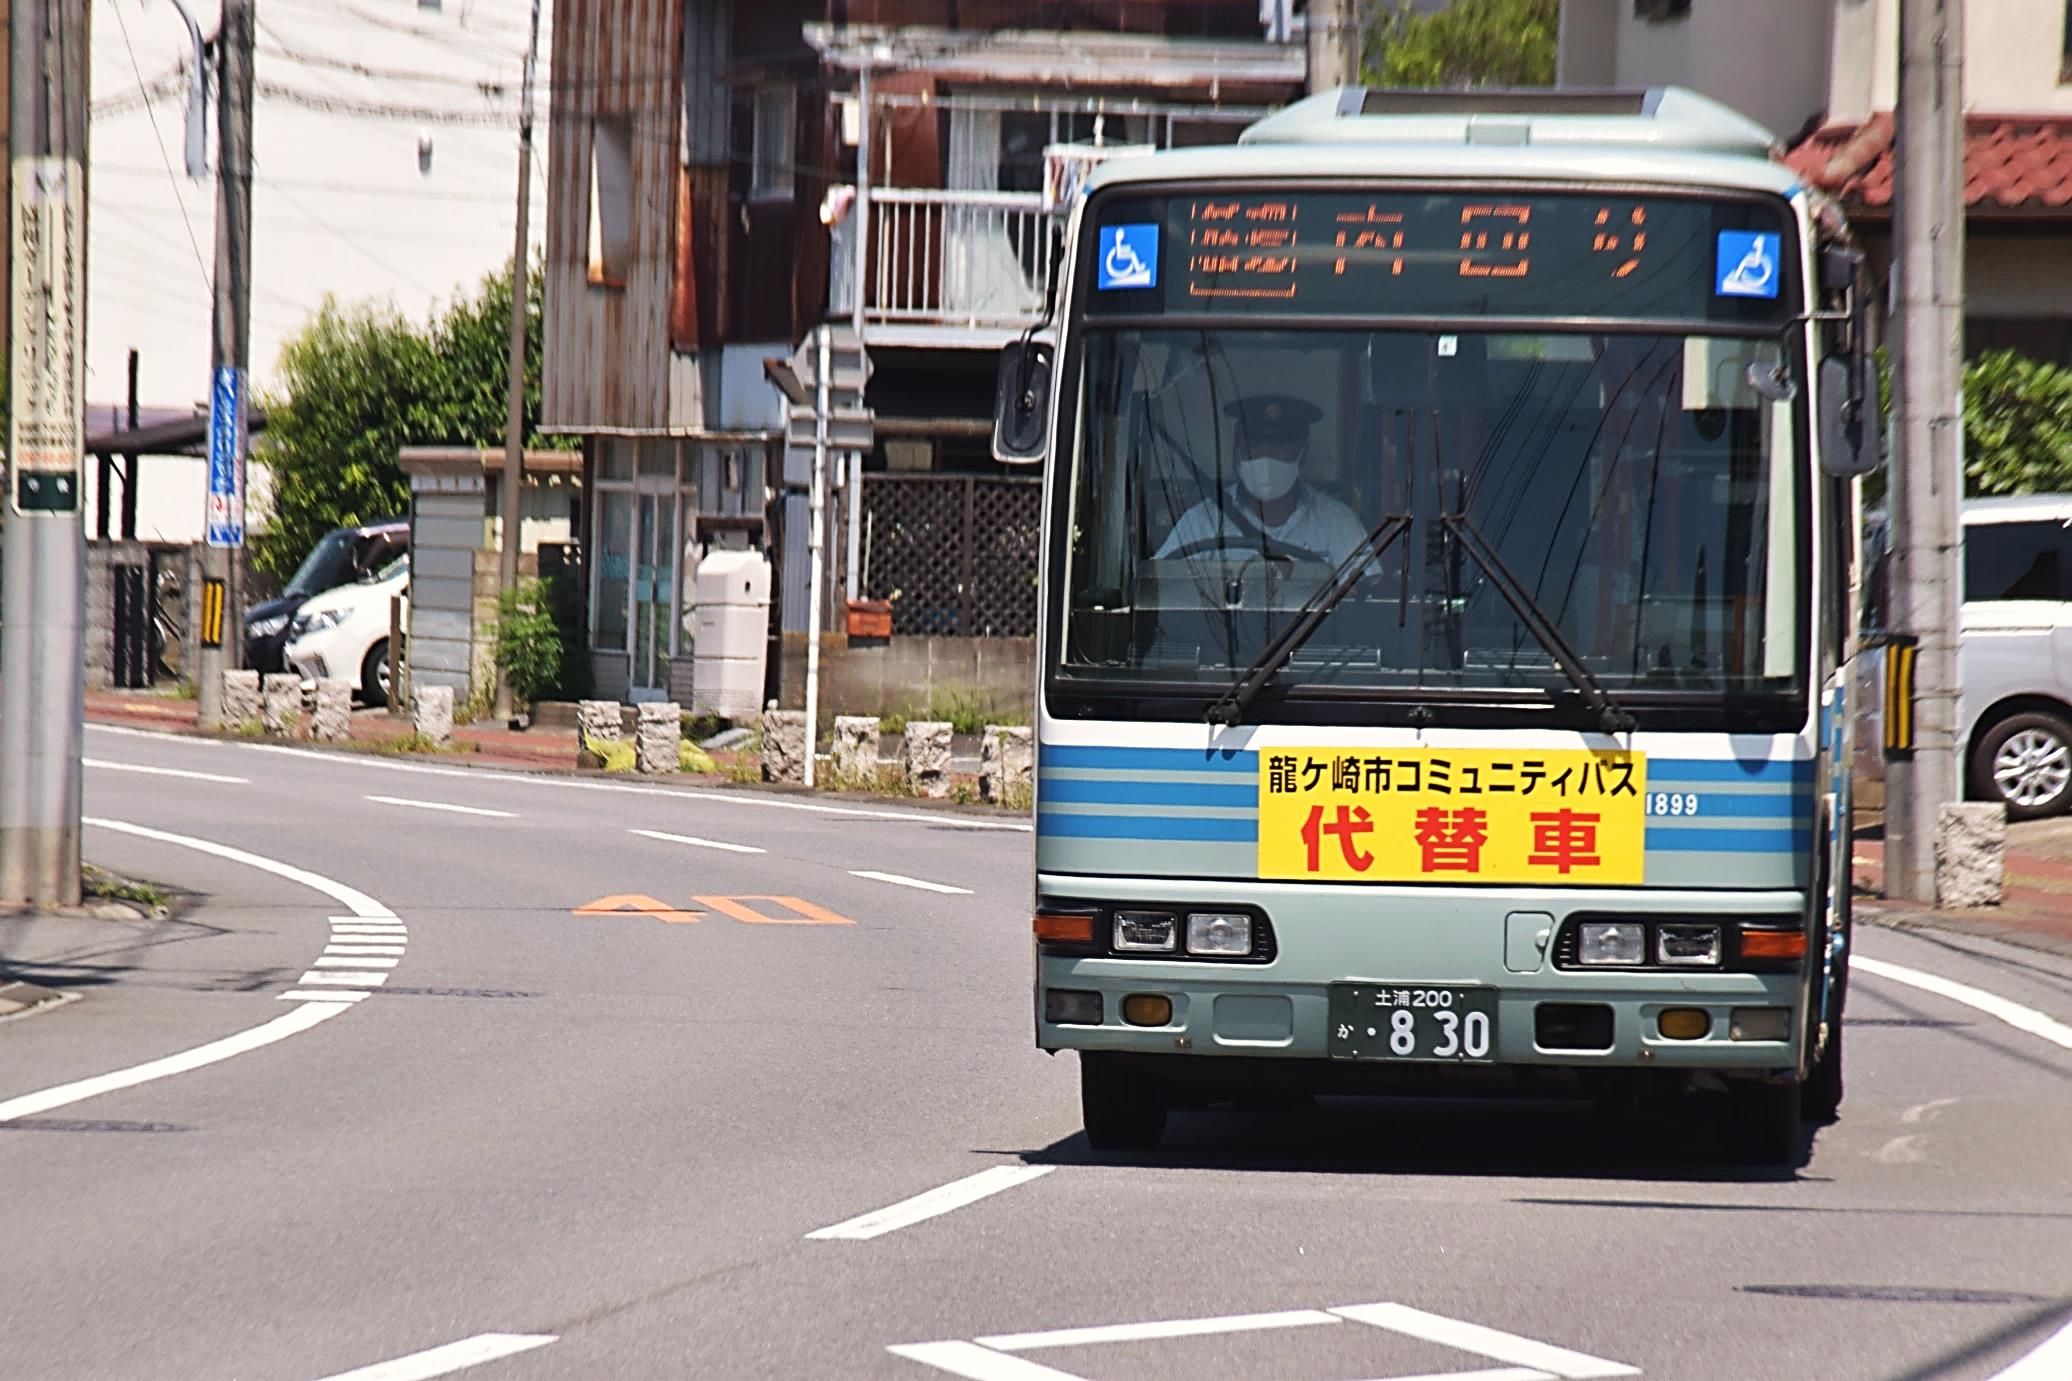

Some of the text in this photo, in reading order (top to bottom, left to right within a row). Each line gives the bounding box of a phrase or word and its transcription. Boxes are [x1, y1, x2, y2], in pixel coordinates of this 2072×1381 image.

[1300, 805, 1601, 874] 代替車
[571, 894, 857, 924] 40
